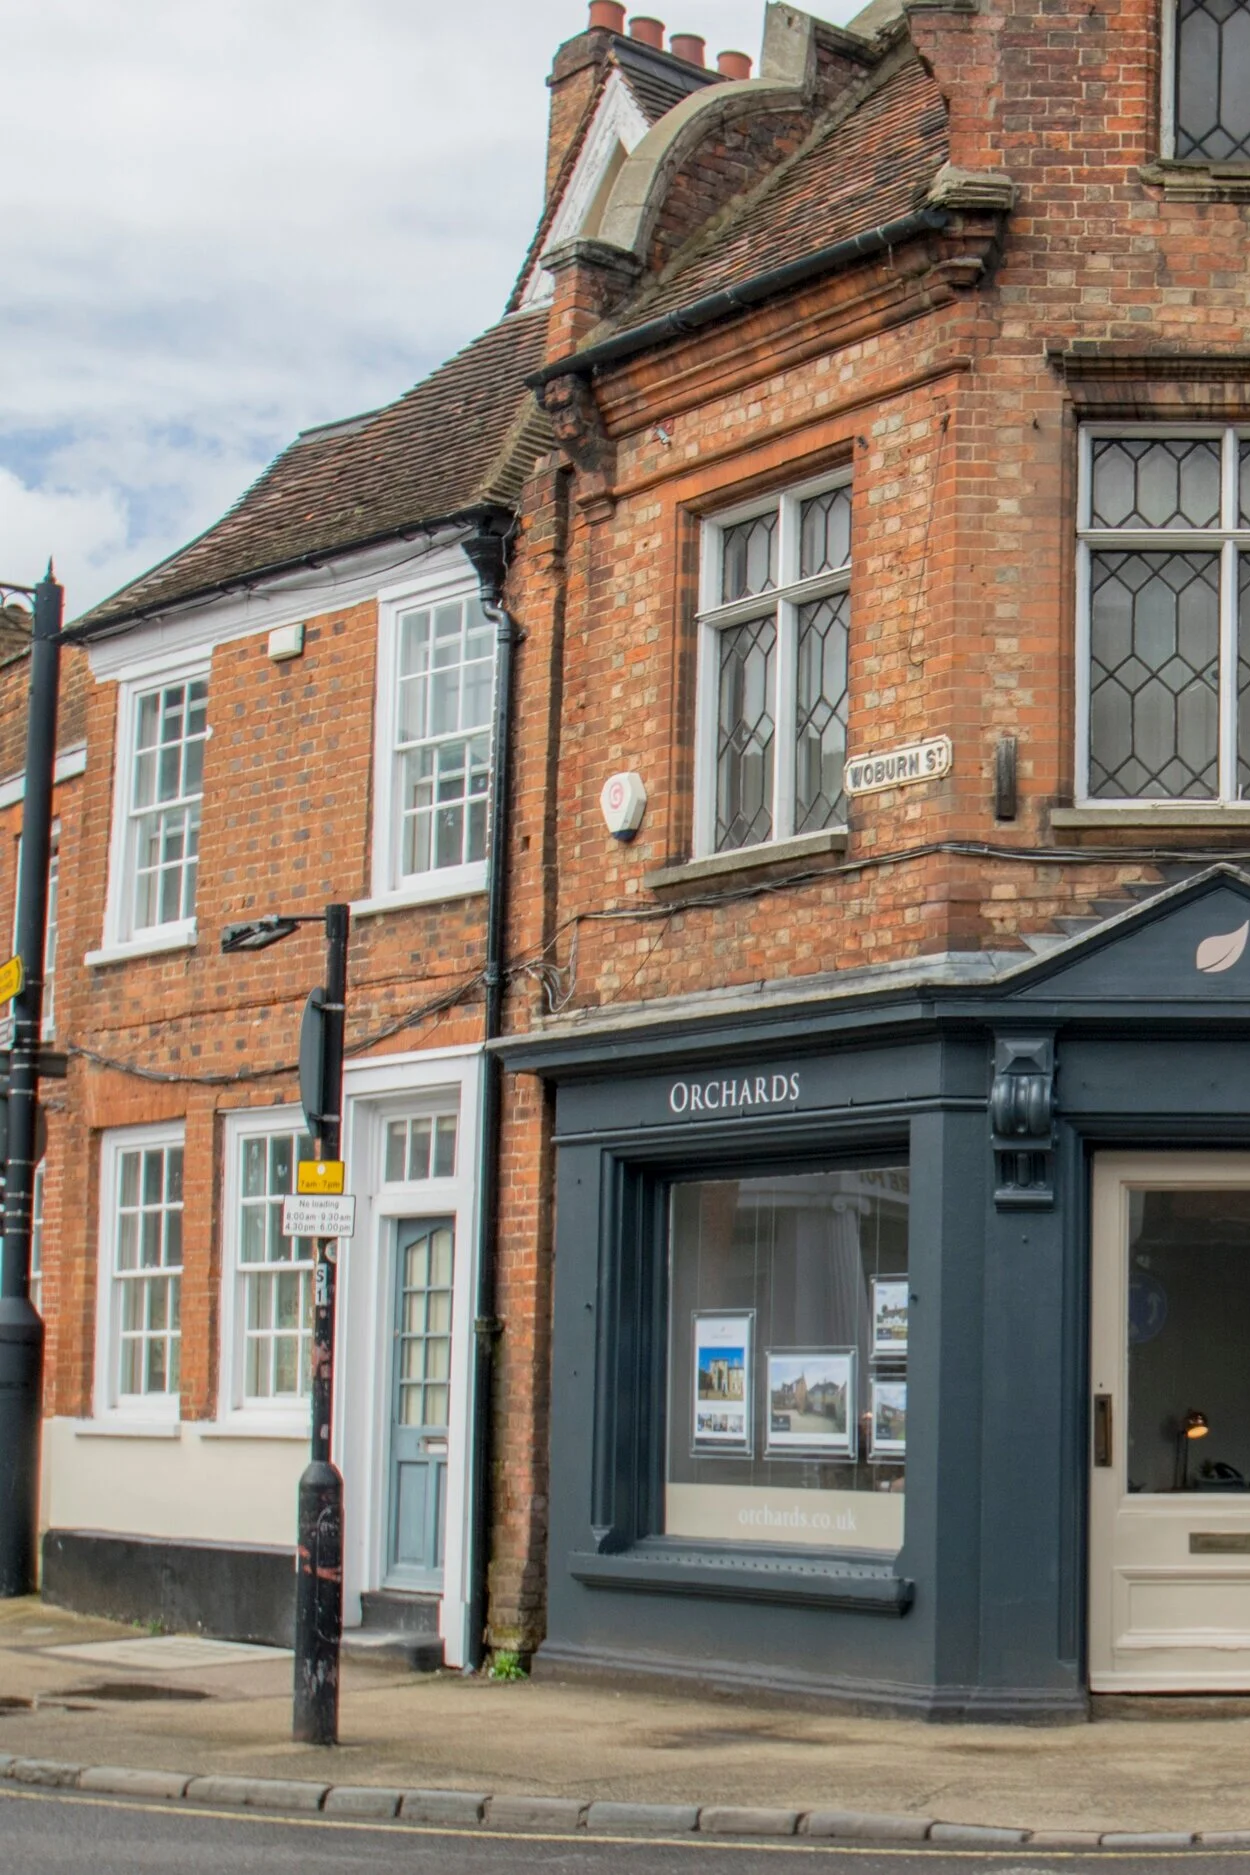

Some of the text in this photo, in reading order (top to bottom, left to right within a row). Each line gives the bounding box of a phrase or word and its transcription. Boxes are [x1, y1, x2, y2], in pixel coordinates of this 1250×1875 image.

[849, 752, 920, 788] WOBURN
[669, 1072, 800, 1113] ORCHARDS
[299, 1199, 339, 1210] No loading
[738, 1502, 857, 1531] orchards.co.uk
